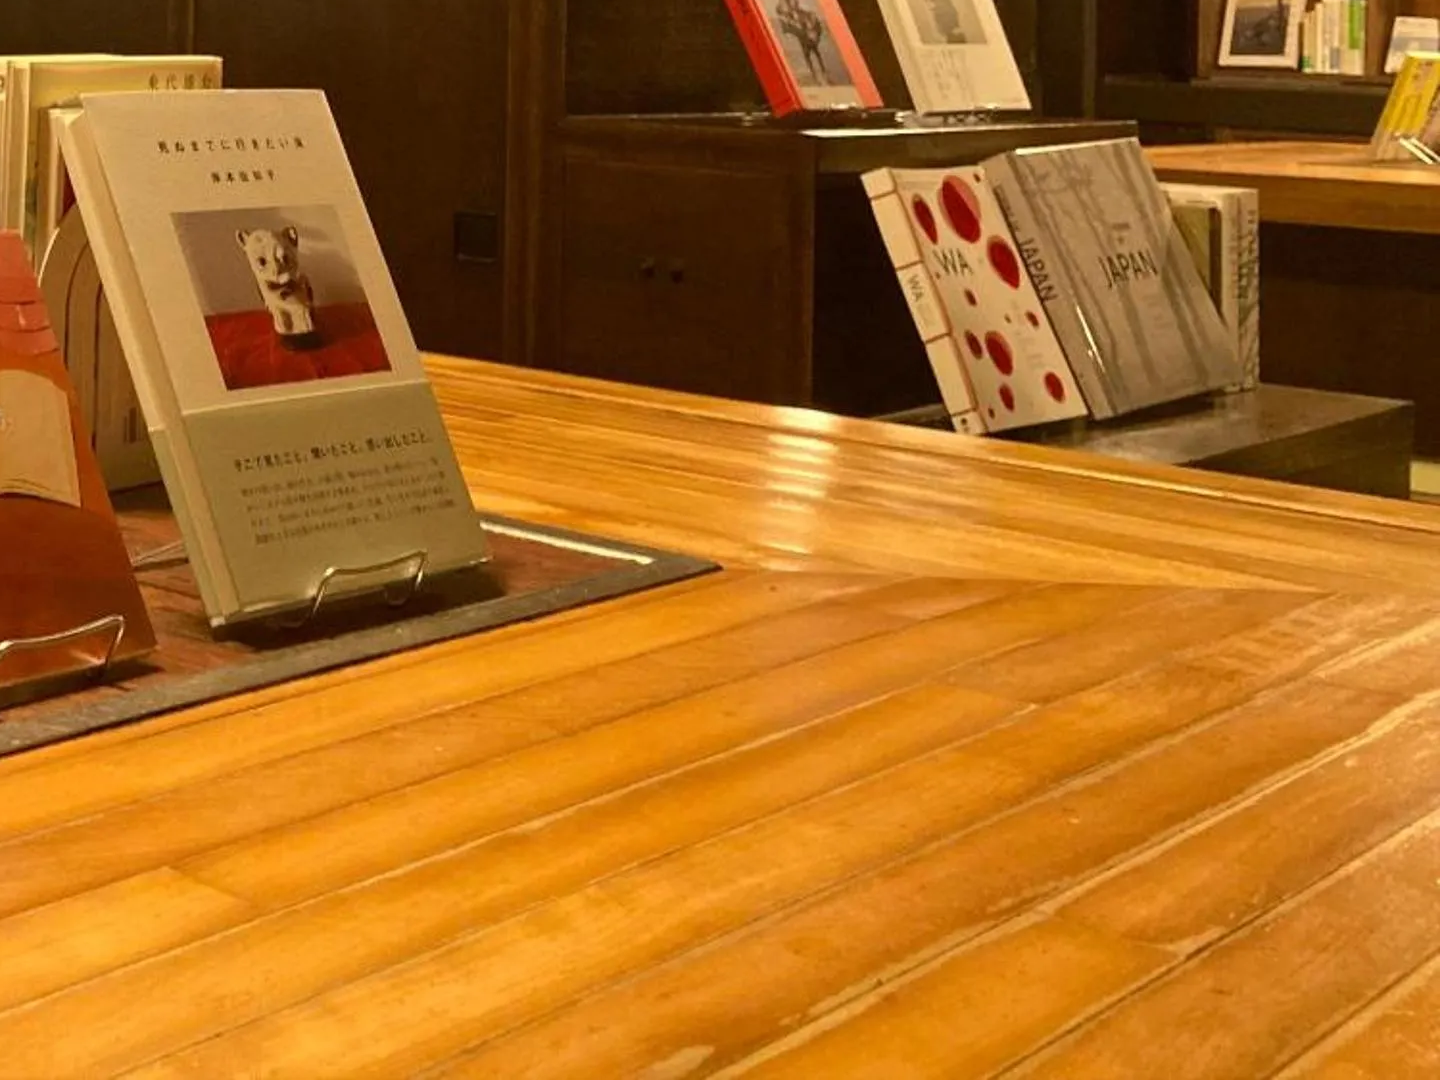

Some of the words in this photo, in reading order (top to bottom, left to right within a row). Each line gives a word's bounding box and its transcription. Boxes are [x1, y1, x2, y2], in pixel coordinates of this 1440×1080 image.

[932, 248, 973, 277] WA
[1021, 237, 1060, 303] JAPAN
[1098, 249, 1158, 289] JAPAN
[906, 273, 923, 304] WA
